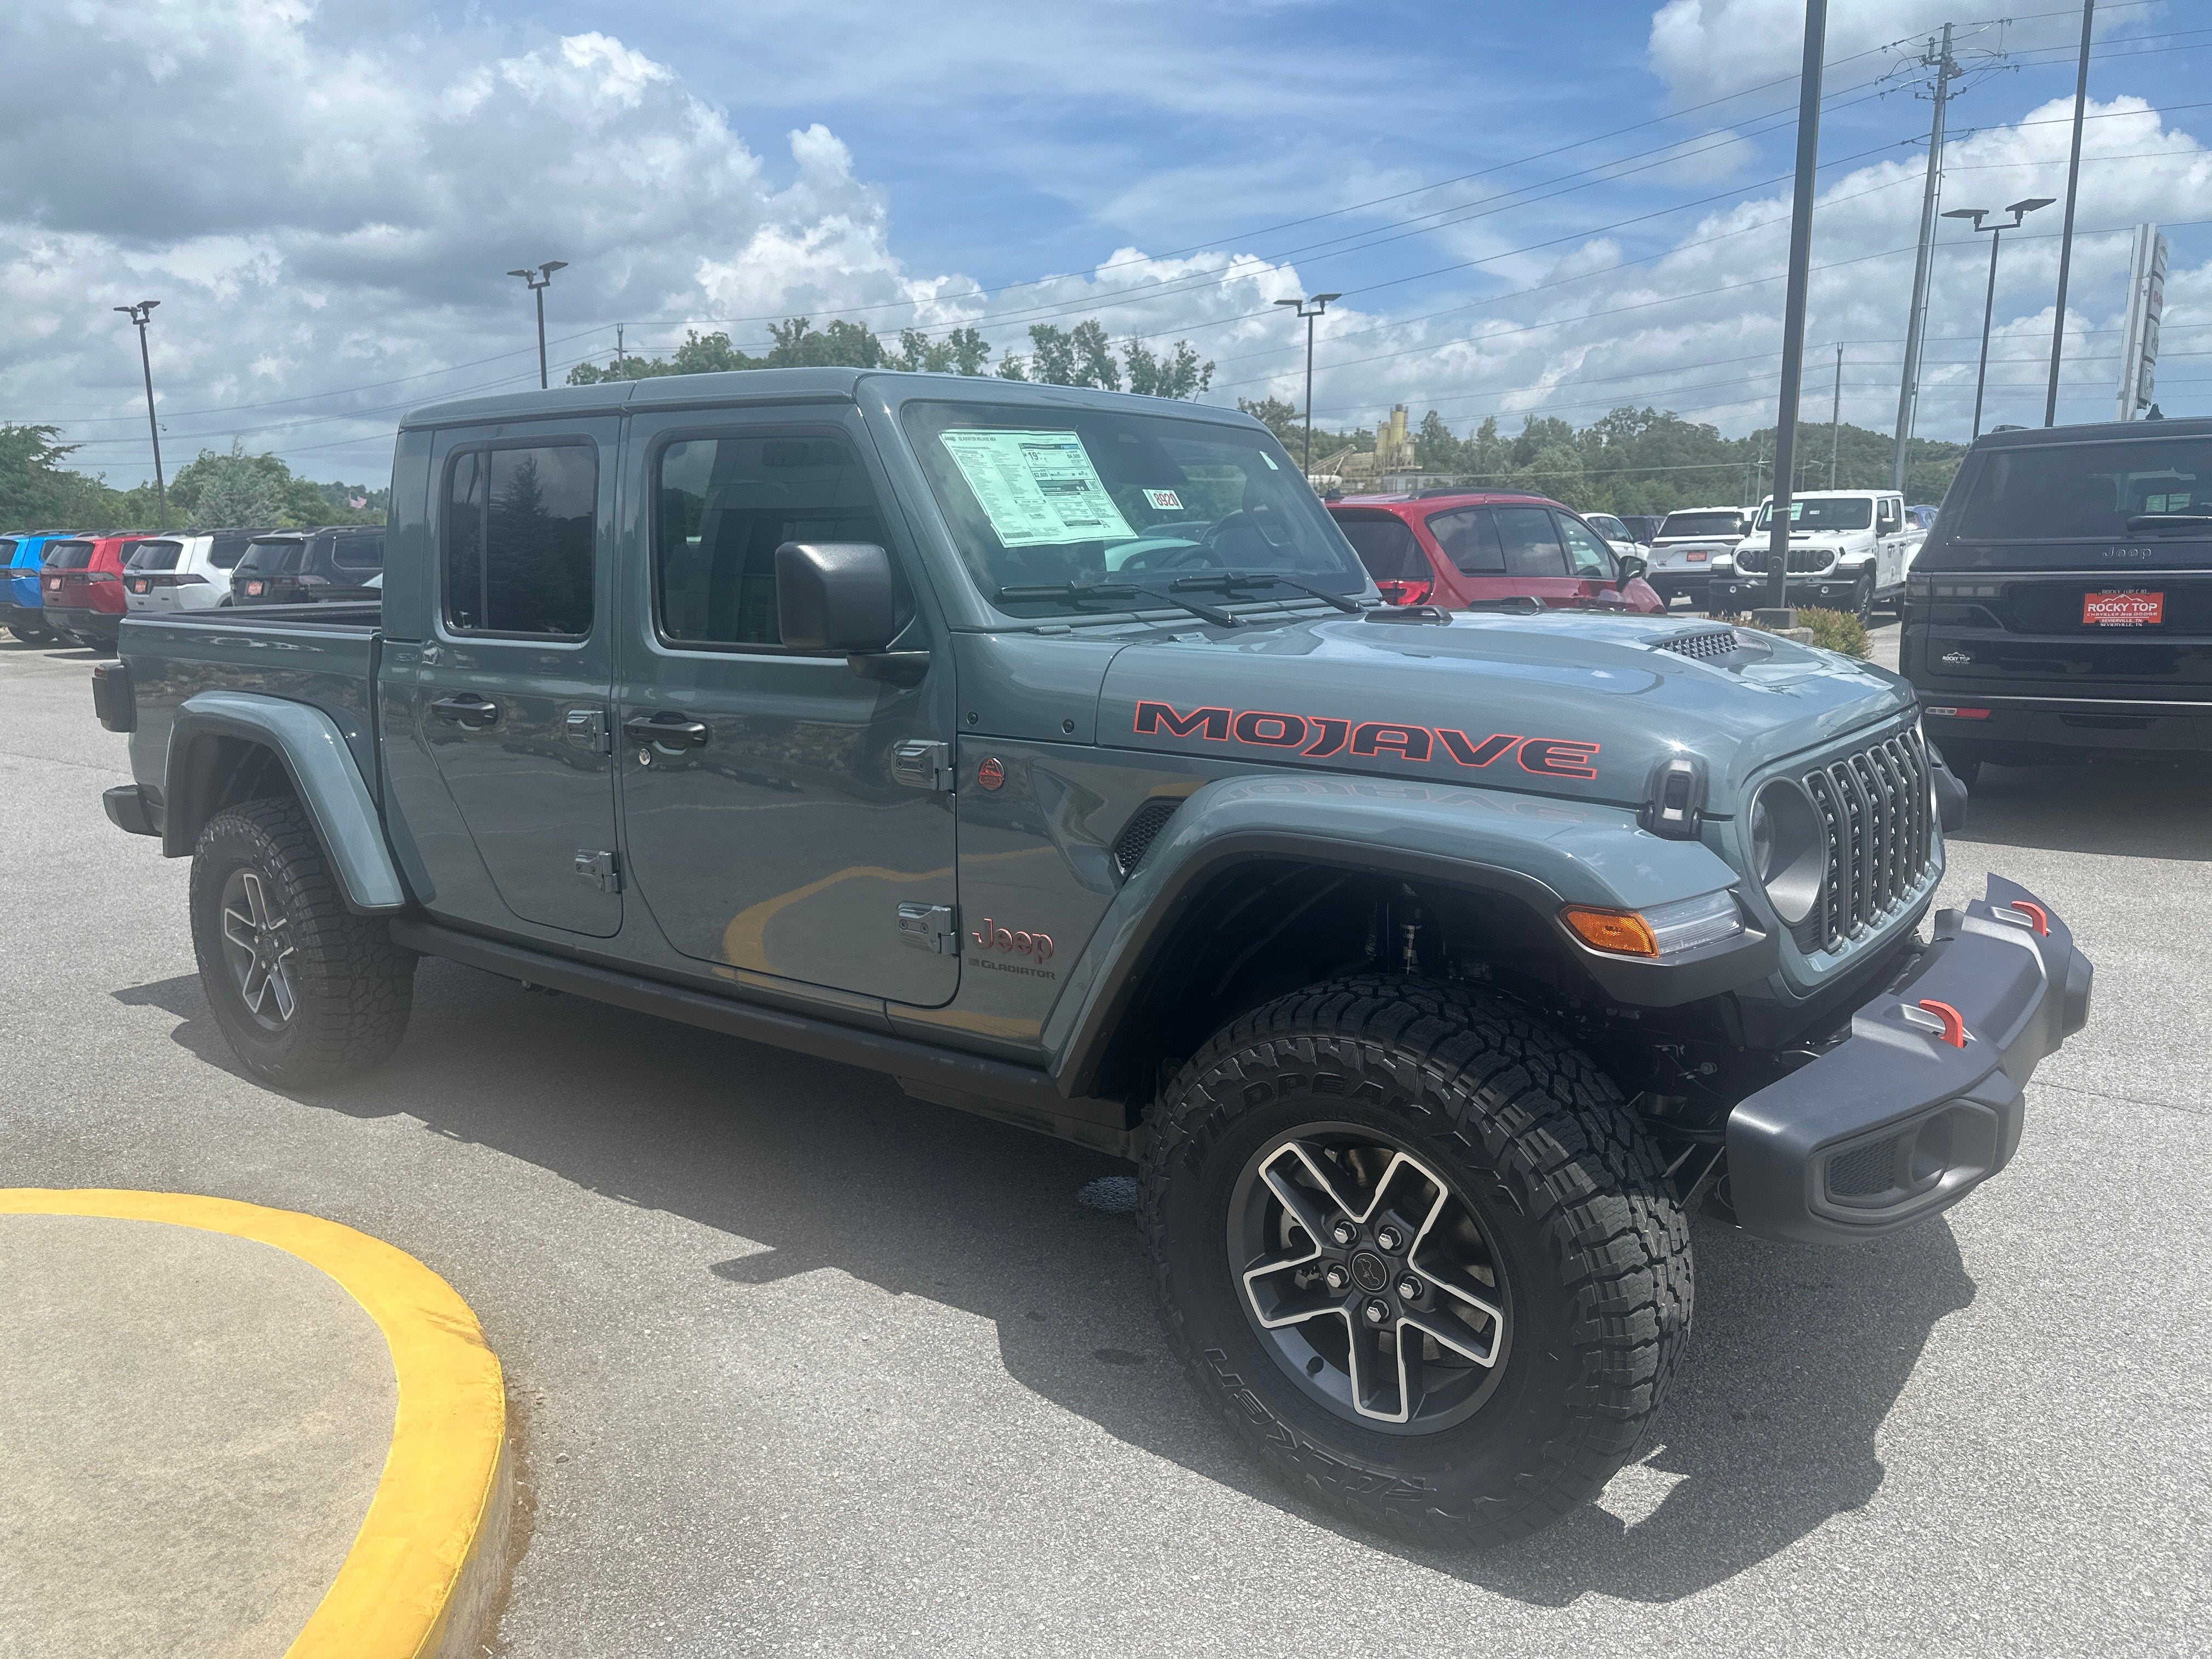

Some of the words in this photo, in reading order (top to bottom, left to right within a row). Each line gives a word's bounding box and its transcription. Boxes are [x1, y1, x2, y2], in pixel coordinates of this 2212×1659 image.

[1028, 452, 1039, 460] 19
[1153, 493, 1179, 506] 8920
[2102, 547, 2151, 559] Jeep
[2087, 603, 2130, 612] ROCKY
[2131, 603, 2158, 612] TOP
[1133, 700, 1601, 780] MOJAVE
[972, 917, 1054, 964] Jeep
[981, 960, 1056, 980] GLADIATOR
